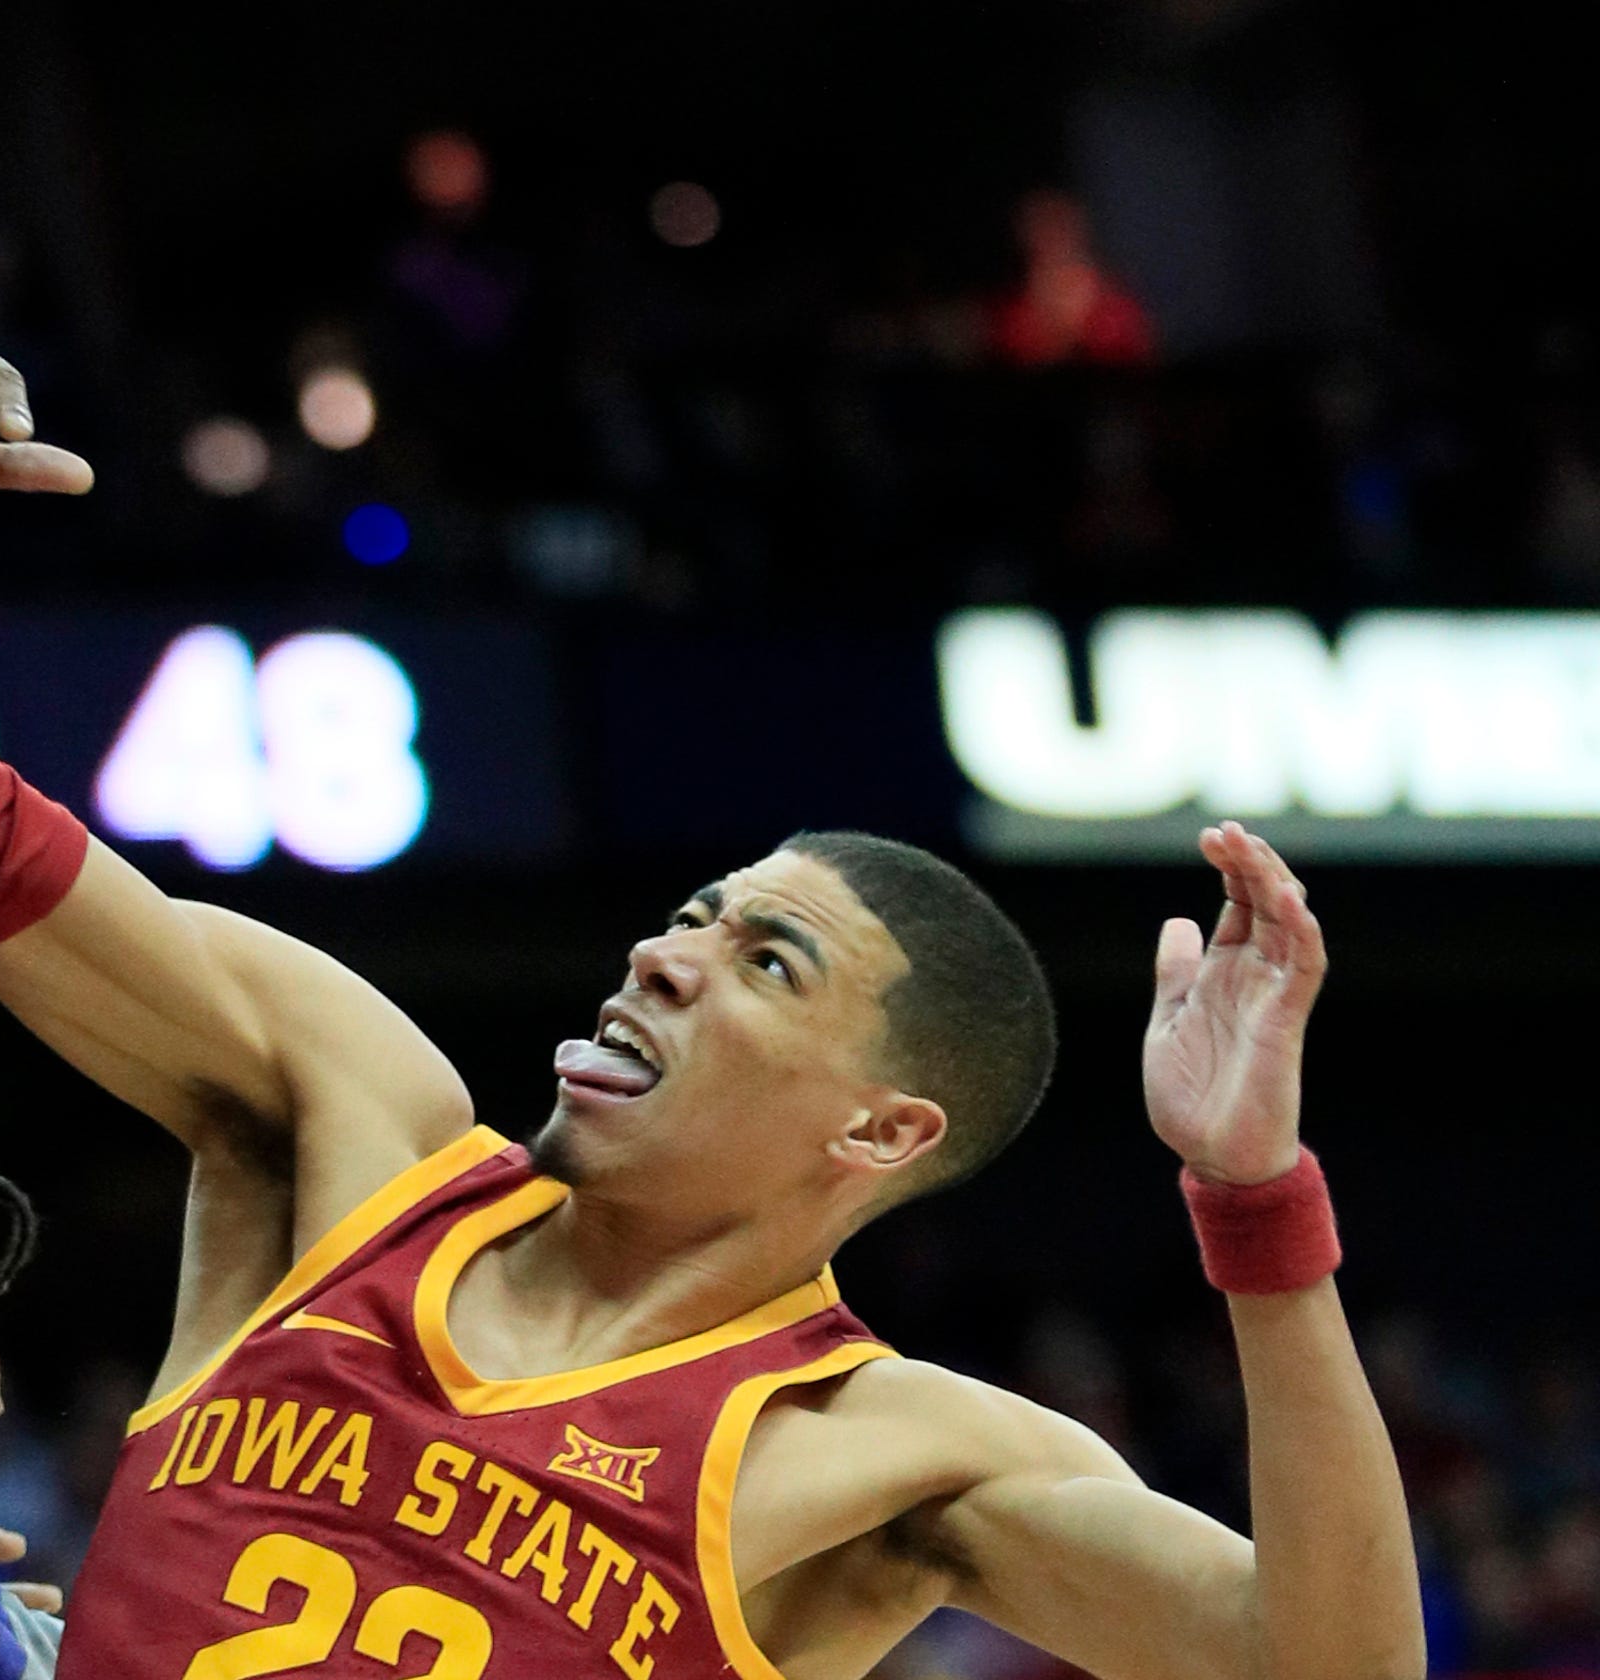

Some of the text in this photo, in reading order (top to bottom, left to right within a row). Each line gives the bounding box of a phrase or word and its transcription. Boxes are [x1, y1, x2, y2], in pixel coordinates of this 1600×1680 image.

[98, 626, 426, 873] 48
[147, 1397, 682, 1680] IOWA STATE
